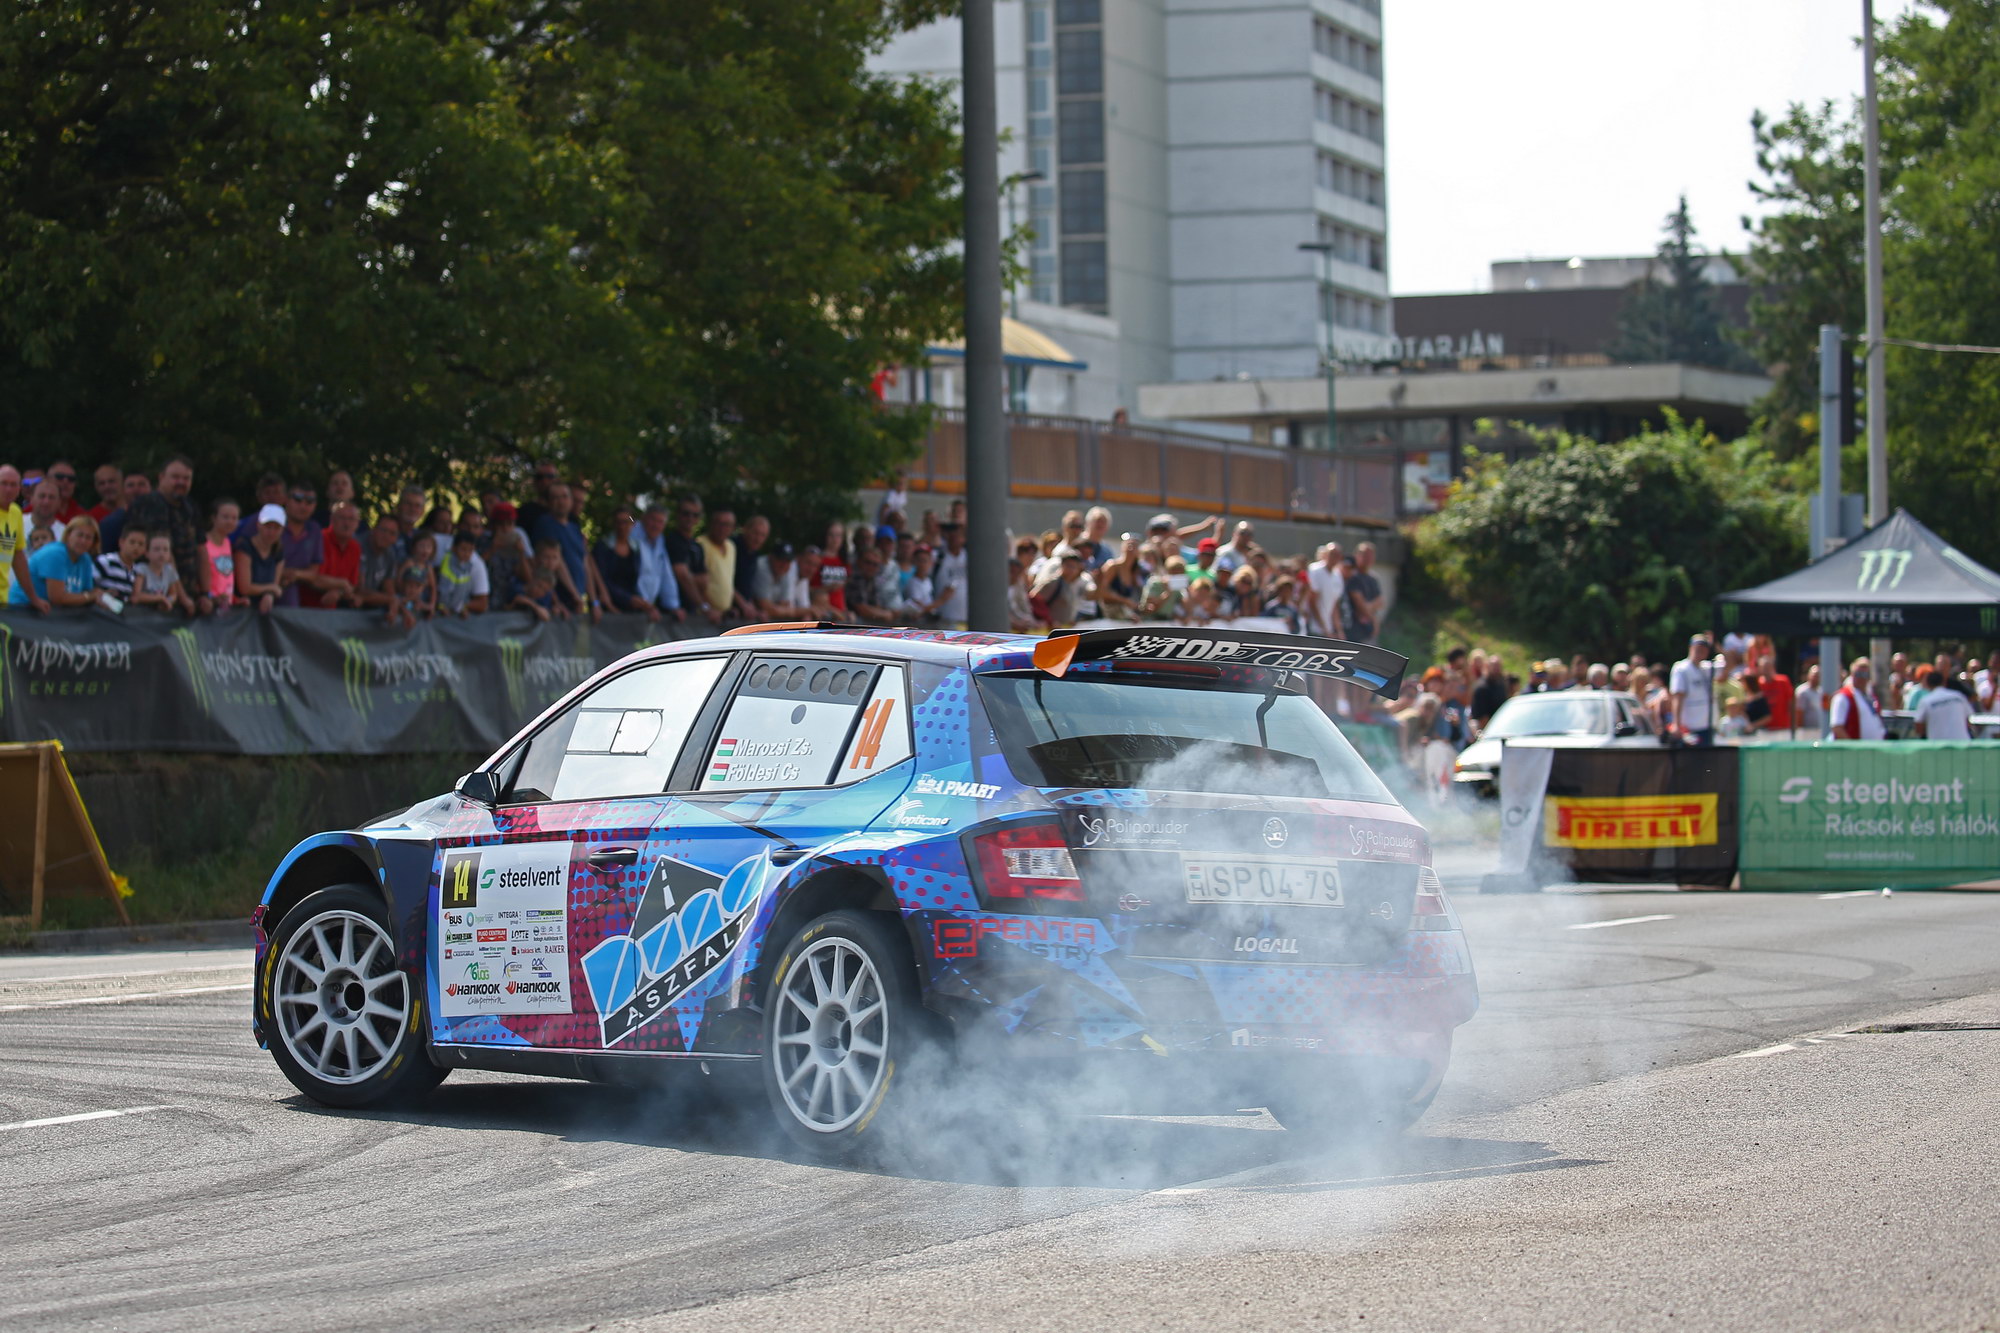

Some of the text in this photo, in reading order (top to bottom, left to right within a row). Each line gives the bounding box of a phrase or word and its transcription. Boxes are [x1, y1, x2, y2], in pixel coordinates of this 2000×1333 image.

[16, 637, 131, 674] MONSTER
[201, 647, 298, 685] MONSTER
[1253, 651, 1355, 673] CARS
[30, 680, 111, 696] ENERGY
[735, 738, 814, 756] Marozsi Zs.
[850, 699, 896, 770] 14
[728, 762, 801, 782] Földesi Cs
[1825, 777, 1964, 804] steelvent
[1106, 818, 1189, 837] Polipowder
[1557, 804, 1703, 839] PIRELLI
[1825, 813, 1999, 837] Rácsok és hálók
[1366, 830, 1416, 849] Polipowder
[453, 859, 471, 902] 14
[499, 865, 561, 889] steelvent
[1212, 865, 1339, 901] SP 04-79
[498, 911, 519, 919] INTEGRA
[977, 918, 1096, 945] PENTA
[626, 914, 748, 1026] ASZFALT
